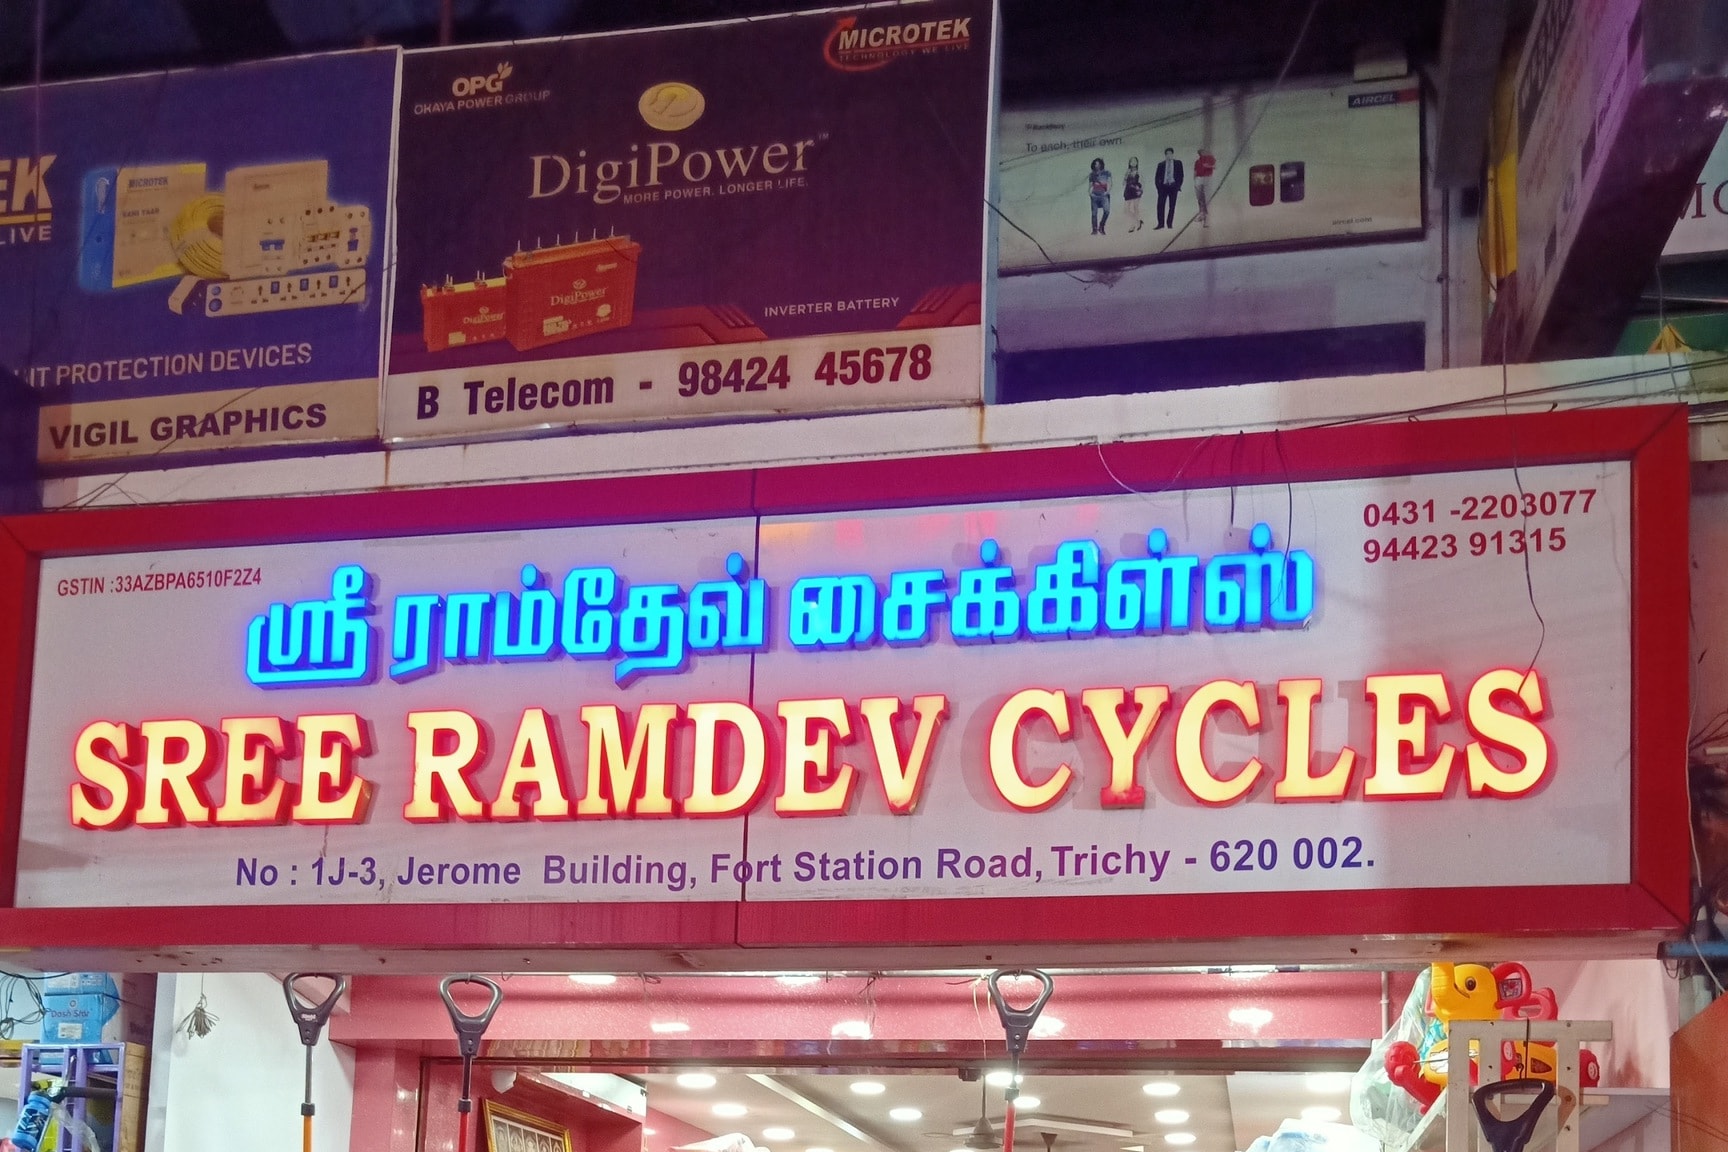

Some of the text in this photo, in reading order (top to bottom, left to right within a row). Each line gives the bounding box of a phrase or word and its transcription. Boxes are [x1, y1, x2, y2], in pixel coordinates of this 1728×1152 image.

[839, 17, 972, 50] MICROTEK
[452, 73, 504, 97] OPG
[1352, 93, 1396, 106] AIRCEL
[414, 90, 551, 115] OKAYA POWER GROUP
[1026, 142, 1038, 153] To
[1099, 135, 1123, 147] own
[528, 139, 815, 205] DigiPower
[623, 191, 660, 205] MORE
[664, 186, 715, 200] POWER.
[719, 180, 774, 195] LONGER
[551, 286, 607, 306] DigiPower
[764, 297, 900, 318] INVERTER BATTERY
[56, 352, 204, 386] PROTECTION
[210, 342, 312, 372] DEVICES
[417, 385, 440, 420] B
[463, 376, 615, 416] Telecom
[678, 355, 791, 397] 98424
[814, 344, 932, 386] 45678
[50, 403, 327, 449] VIGIL GRAPHICS
[1363, 498, 1435, 528] 0431
[1363, 527, 1567, 563] 94423 91315
[57, 575, 105, 597] GSTIN
[69, 665, 1553, 830] SREE RAMDEV CYCLES
[235, 857, 279, 886] No
[310, 856, 386, 890] 1J-3,
[397, 856, 522, 886] Jerome
[543, 854, 698, 892] Building,
[710, 852, 782, 883] Fort
[794, 849, 922, 882] Station
[936, 846, 1043, 883] Road,
[1050, 843, 1171, 882] Trichy
[1210, 838, 1278, 872] 620
[1293, 836, 1375, 870] 002.
